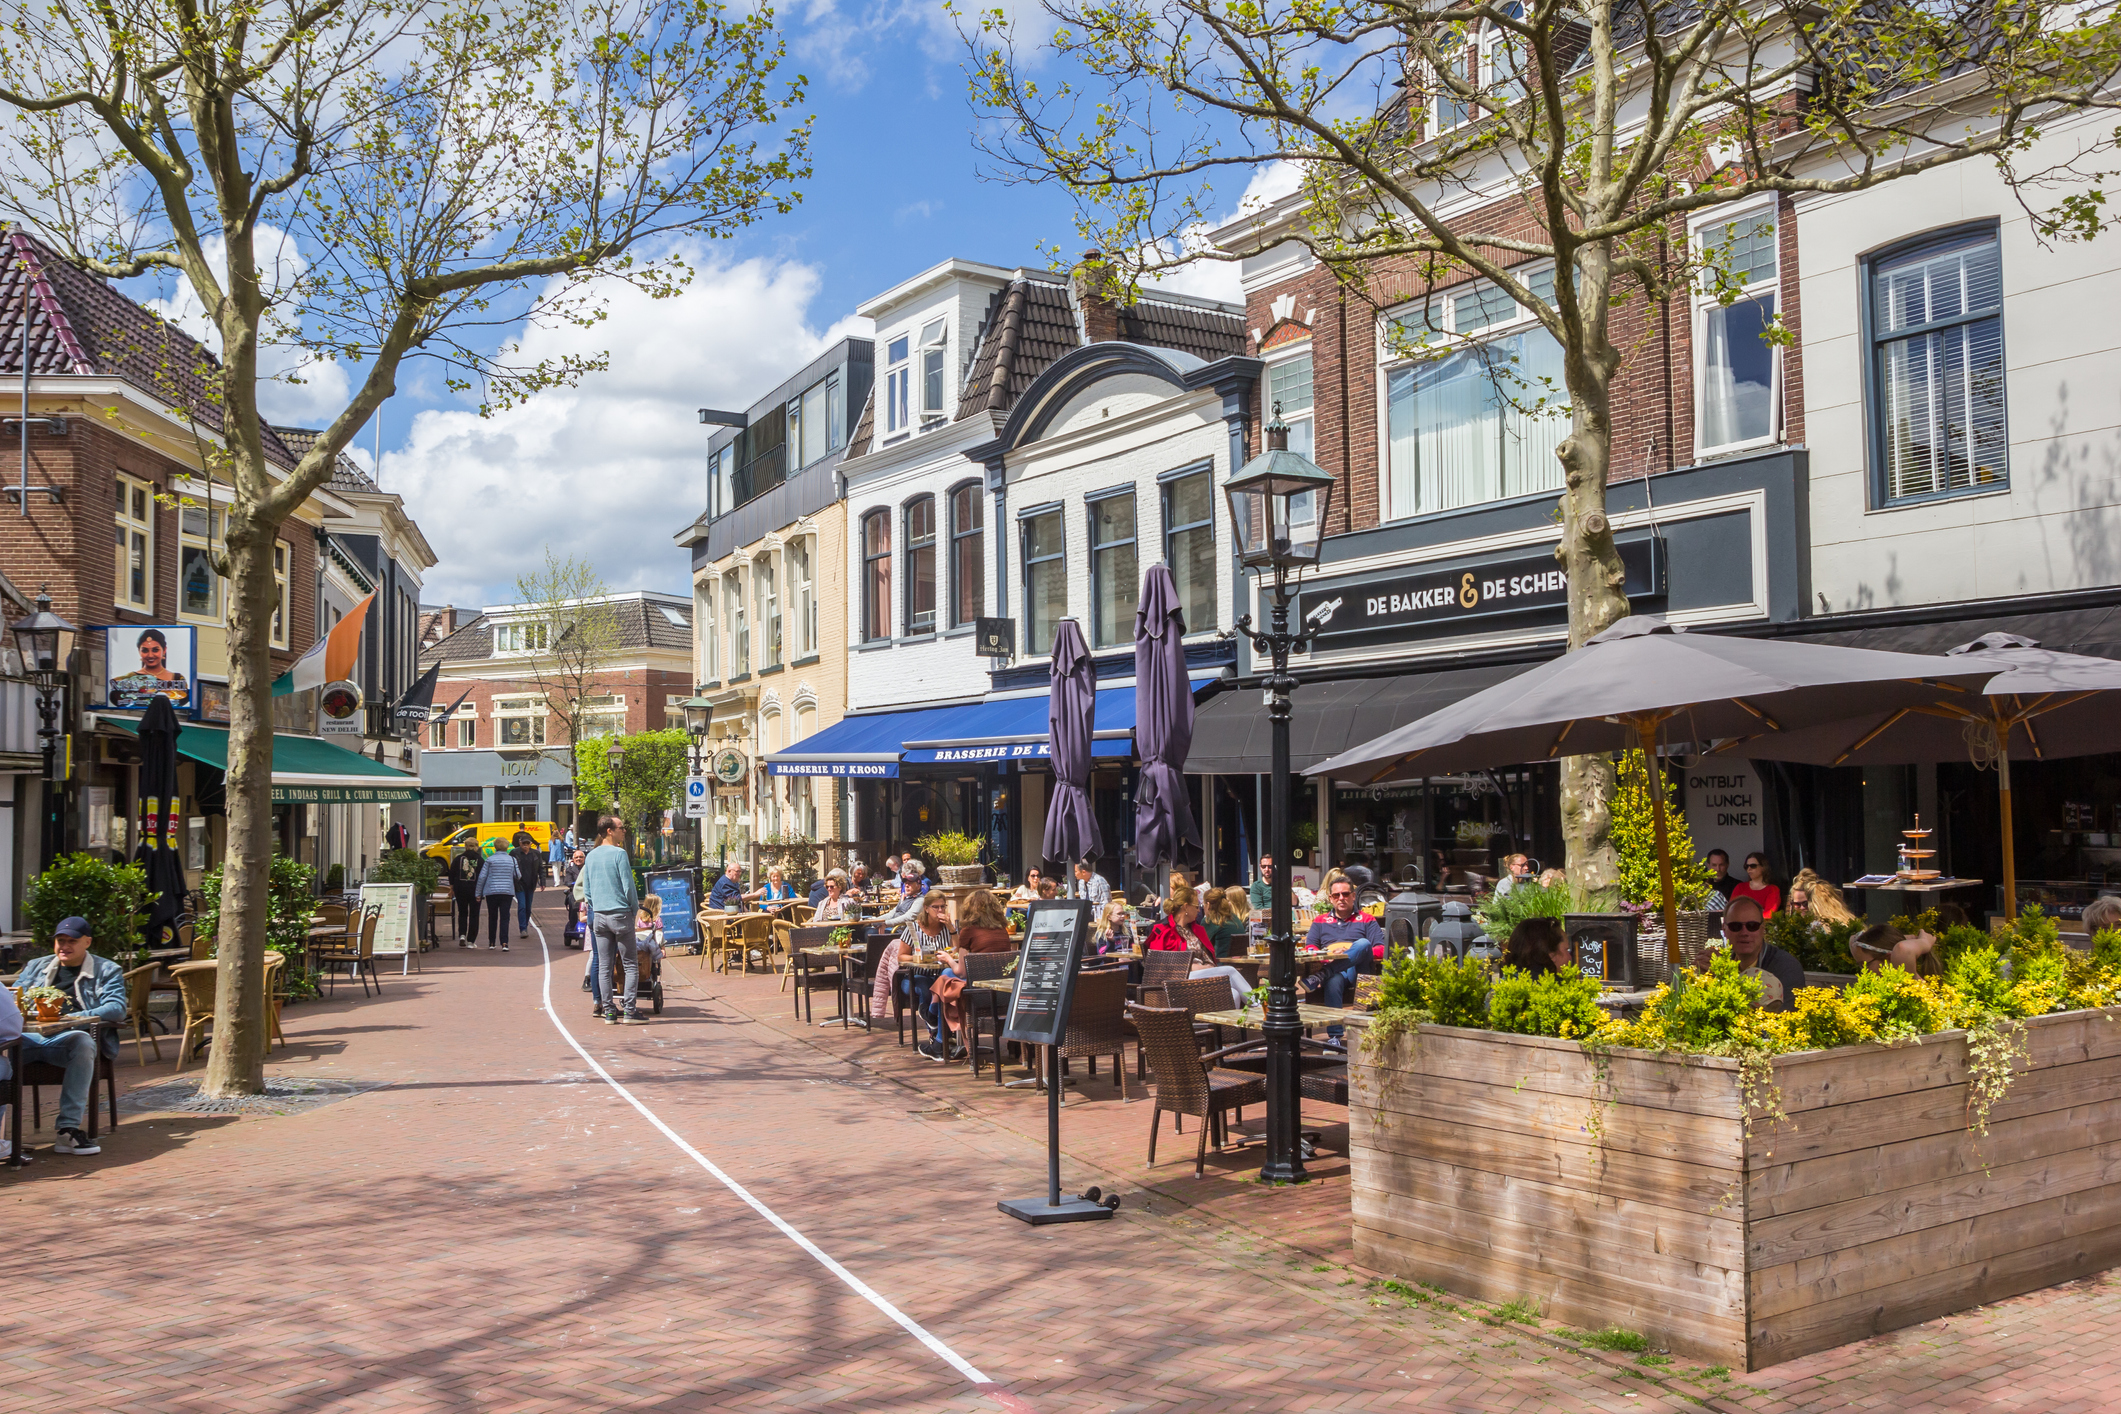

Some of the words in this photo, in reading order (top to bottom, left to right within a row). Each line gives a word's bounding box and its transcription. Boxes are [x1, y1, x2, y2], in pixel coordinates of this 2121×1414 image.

[1366, 597, 1388, 616] DE
[1390, 586, 1455, 613] BAKKER
[1459, 572, 1479, 609] &
[1482, 579, 1506, 600] DE
[979, 644, 998, 654] Hertog
[145, 680, 188, 690] DELHI
[934, 747, 1007, 760] BRASSERIE
[1012, 746, 1032, 756] DE
[501, 761, 537, 776] NOYA
[776, 765, 829, 774] BRASSERIE
[832, 765, 846, 774] DE
[848, 765, 886, 775] KROON
[1689, 775, 1746, 789] ONTBIJT
[289, 789, 318, 800] INDIAAS
[322, 789, 341, 800] GRILL
[345, 790, 351, 800] &
[354, 790, 373, 800] CURRY
[377, 790, 412, 800] RESTAURANT
[1706, 794, 1752, 808] LUNCH
[1717, 813, 1757, 826] DINER
[1294, 850, 1302, 858] 16
